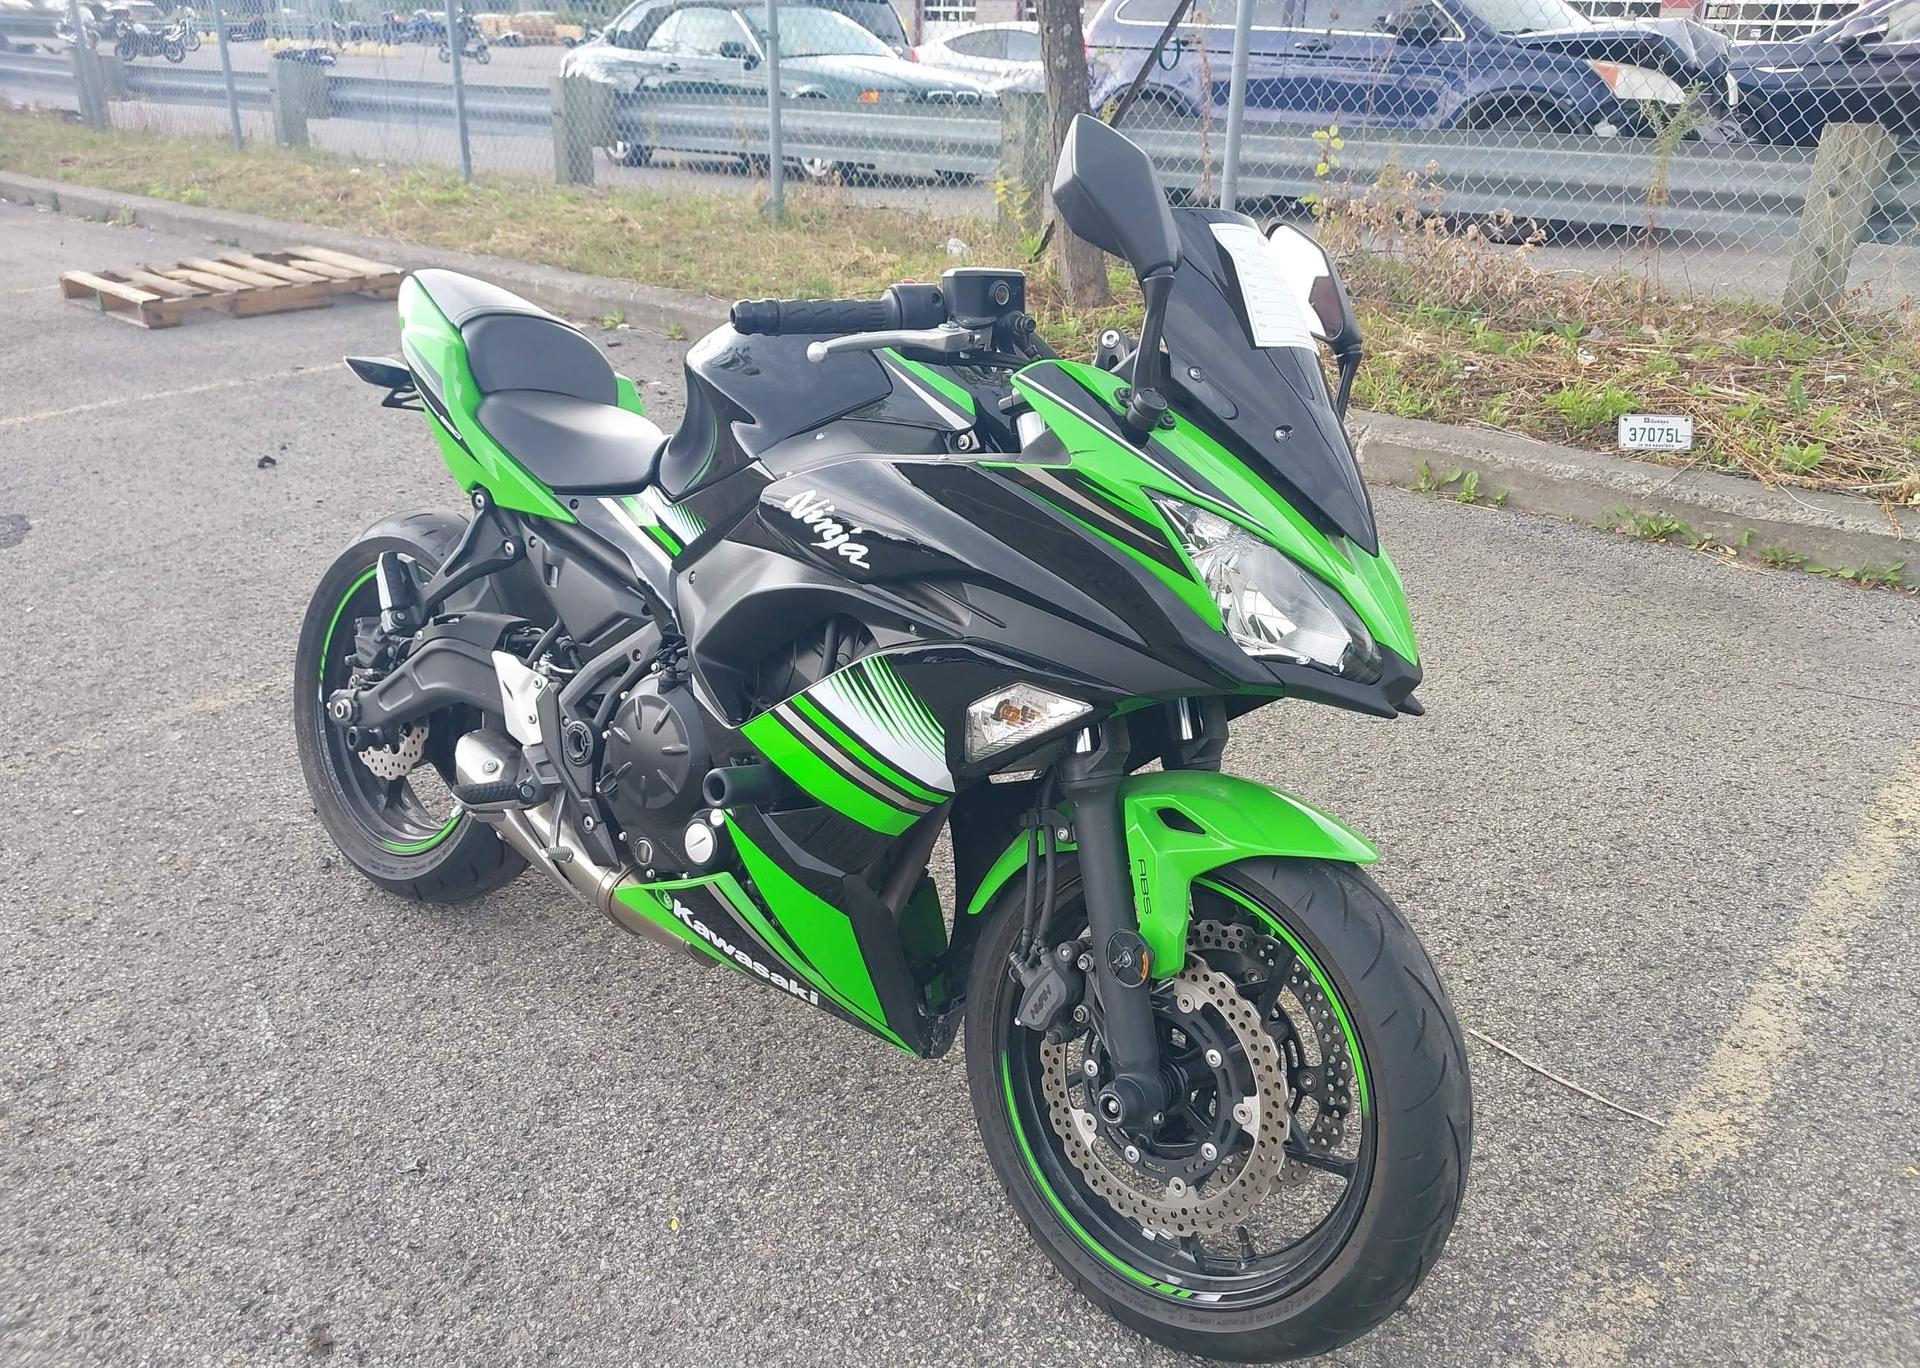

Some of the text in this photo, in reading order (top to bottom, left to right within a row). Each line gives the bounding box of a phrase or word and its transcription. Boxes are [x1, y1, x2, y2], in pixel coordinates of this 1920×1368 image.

[1629, 427, 1682, 443] 37075L
[784, 489, 870, 569] Ninja
[1138, 859, 1152, 914] ABS
[673, 898, 819, 1006] Kawasaki
